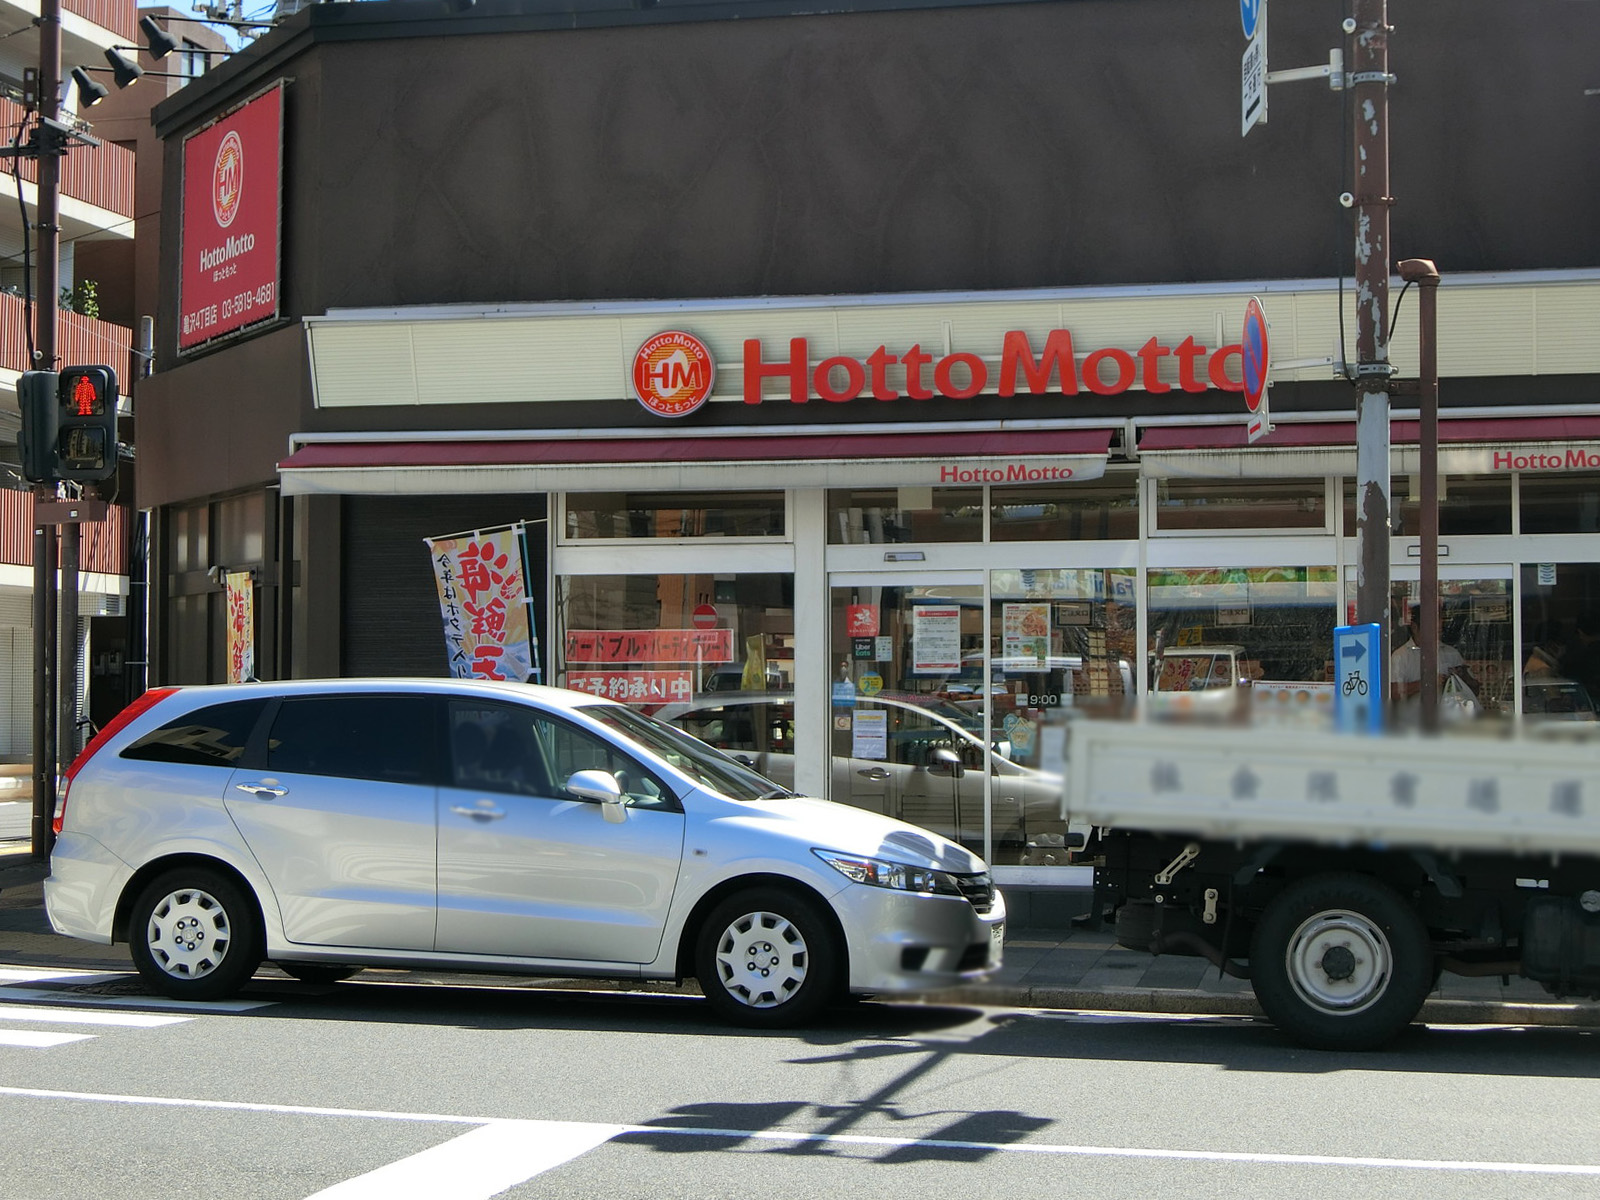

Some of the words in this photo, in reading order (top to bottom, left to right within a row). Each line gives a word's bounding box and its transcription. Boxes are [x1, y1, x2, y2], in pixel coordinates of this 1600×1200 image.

[200, 233, 255, 273] HottoMotto
[213, 263, 237, 282] ほっともっと
[222, 282, 275, 319] 03-5819-4681
[640, 334, 704, 360] HottoMotto
[642, 361, 703, 391] HM
[742, 328, 1244, 405] HottoMotto
[647, 396, 699, 413] ほっともっと
[939, 464, 1074, 483] HottoMotto
[1030, 694, 1057, 705] 9:00
